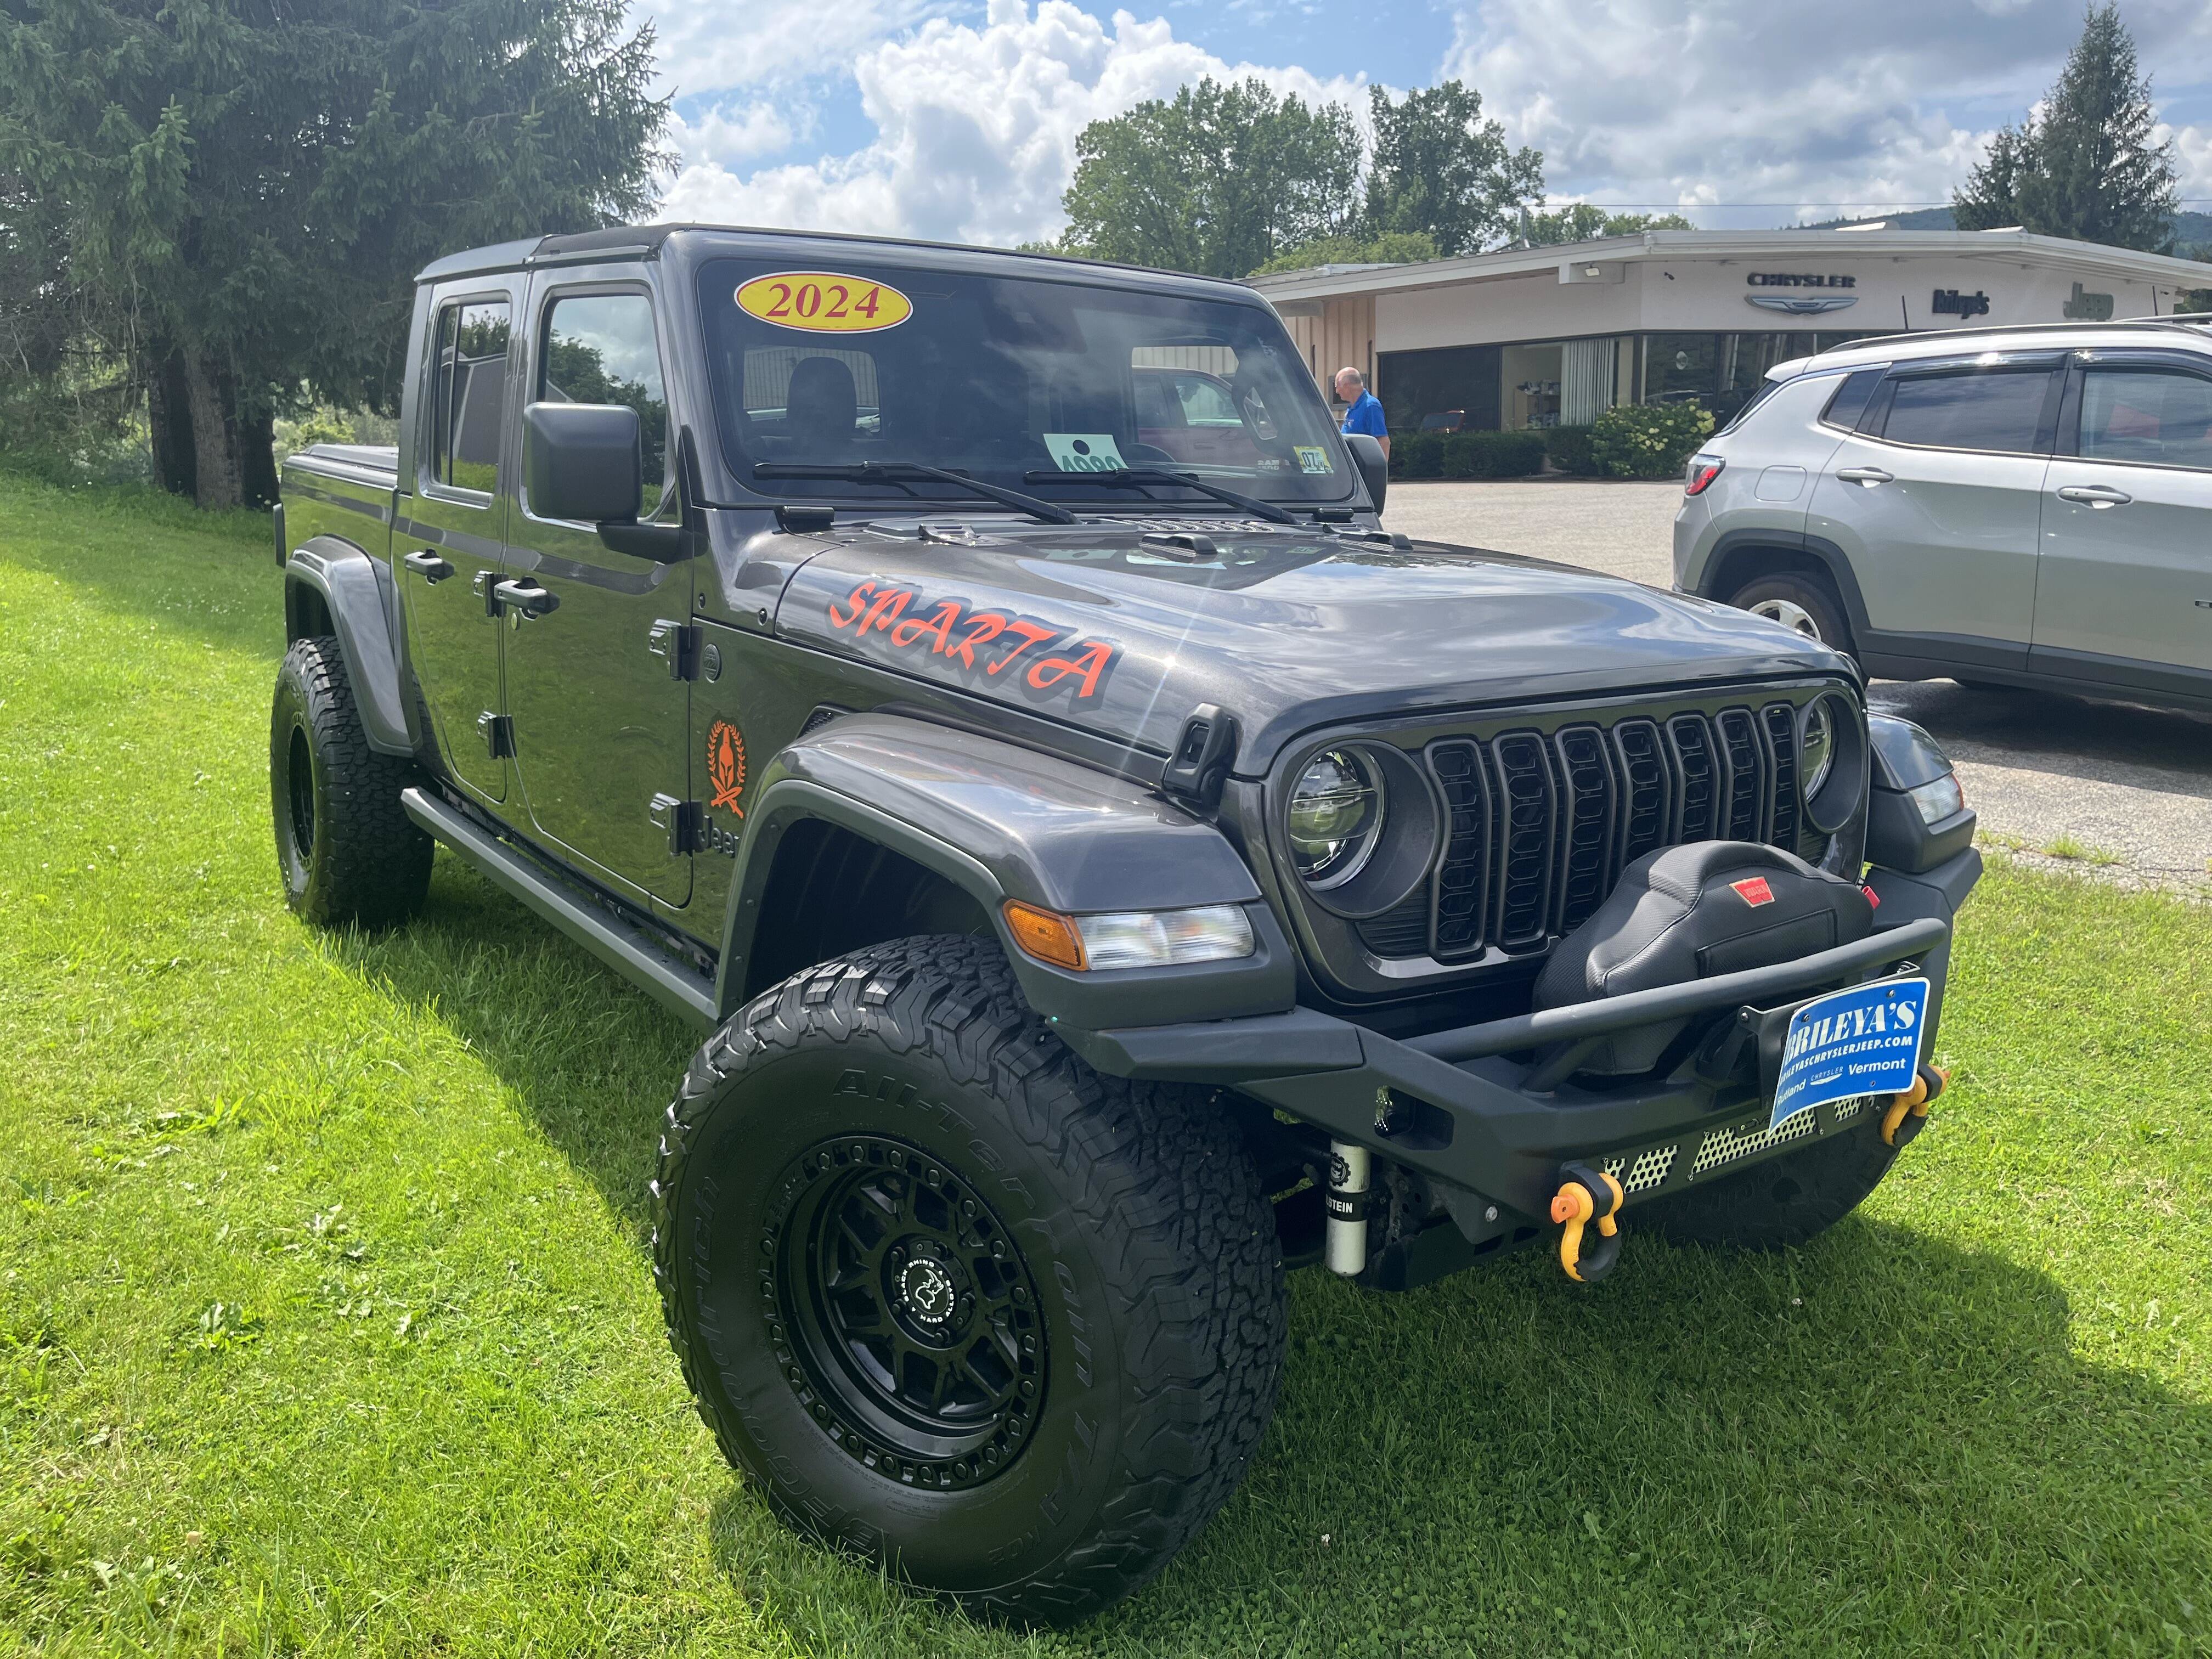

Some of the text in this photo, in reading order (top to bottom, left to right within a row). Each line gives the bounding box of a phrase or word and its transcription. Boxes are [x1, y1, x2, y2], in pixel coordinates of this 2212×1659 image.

[766, 283, 880, 318] 2024
[1747, 273, 1856, 287] CHRYSLER
[830, 582, 1113, 698] SPARTA
[1784, 1001, 1916, 1068] BRILEYA'S
[1777, 1058, 1906, 1108] Rutland CHRYSLER Vermont
[909, 1259, 934, 1268] RHINO
